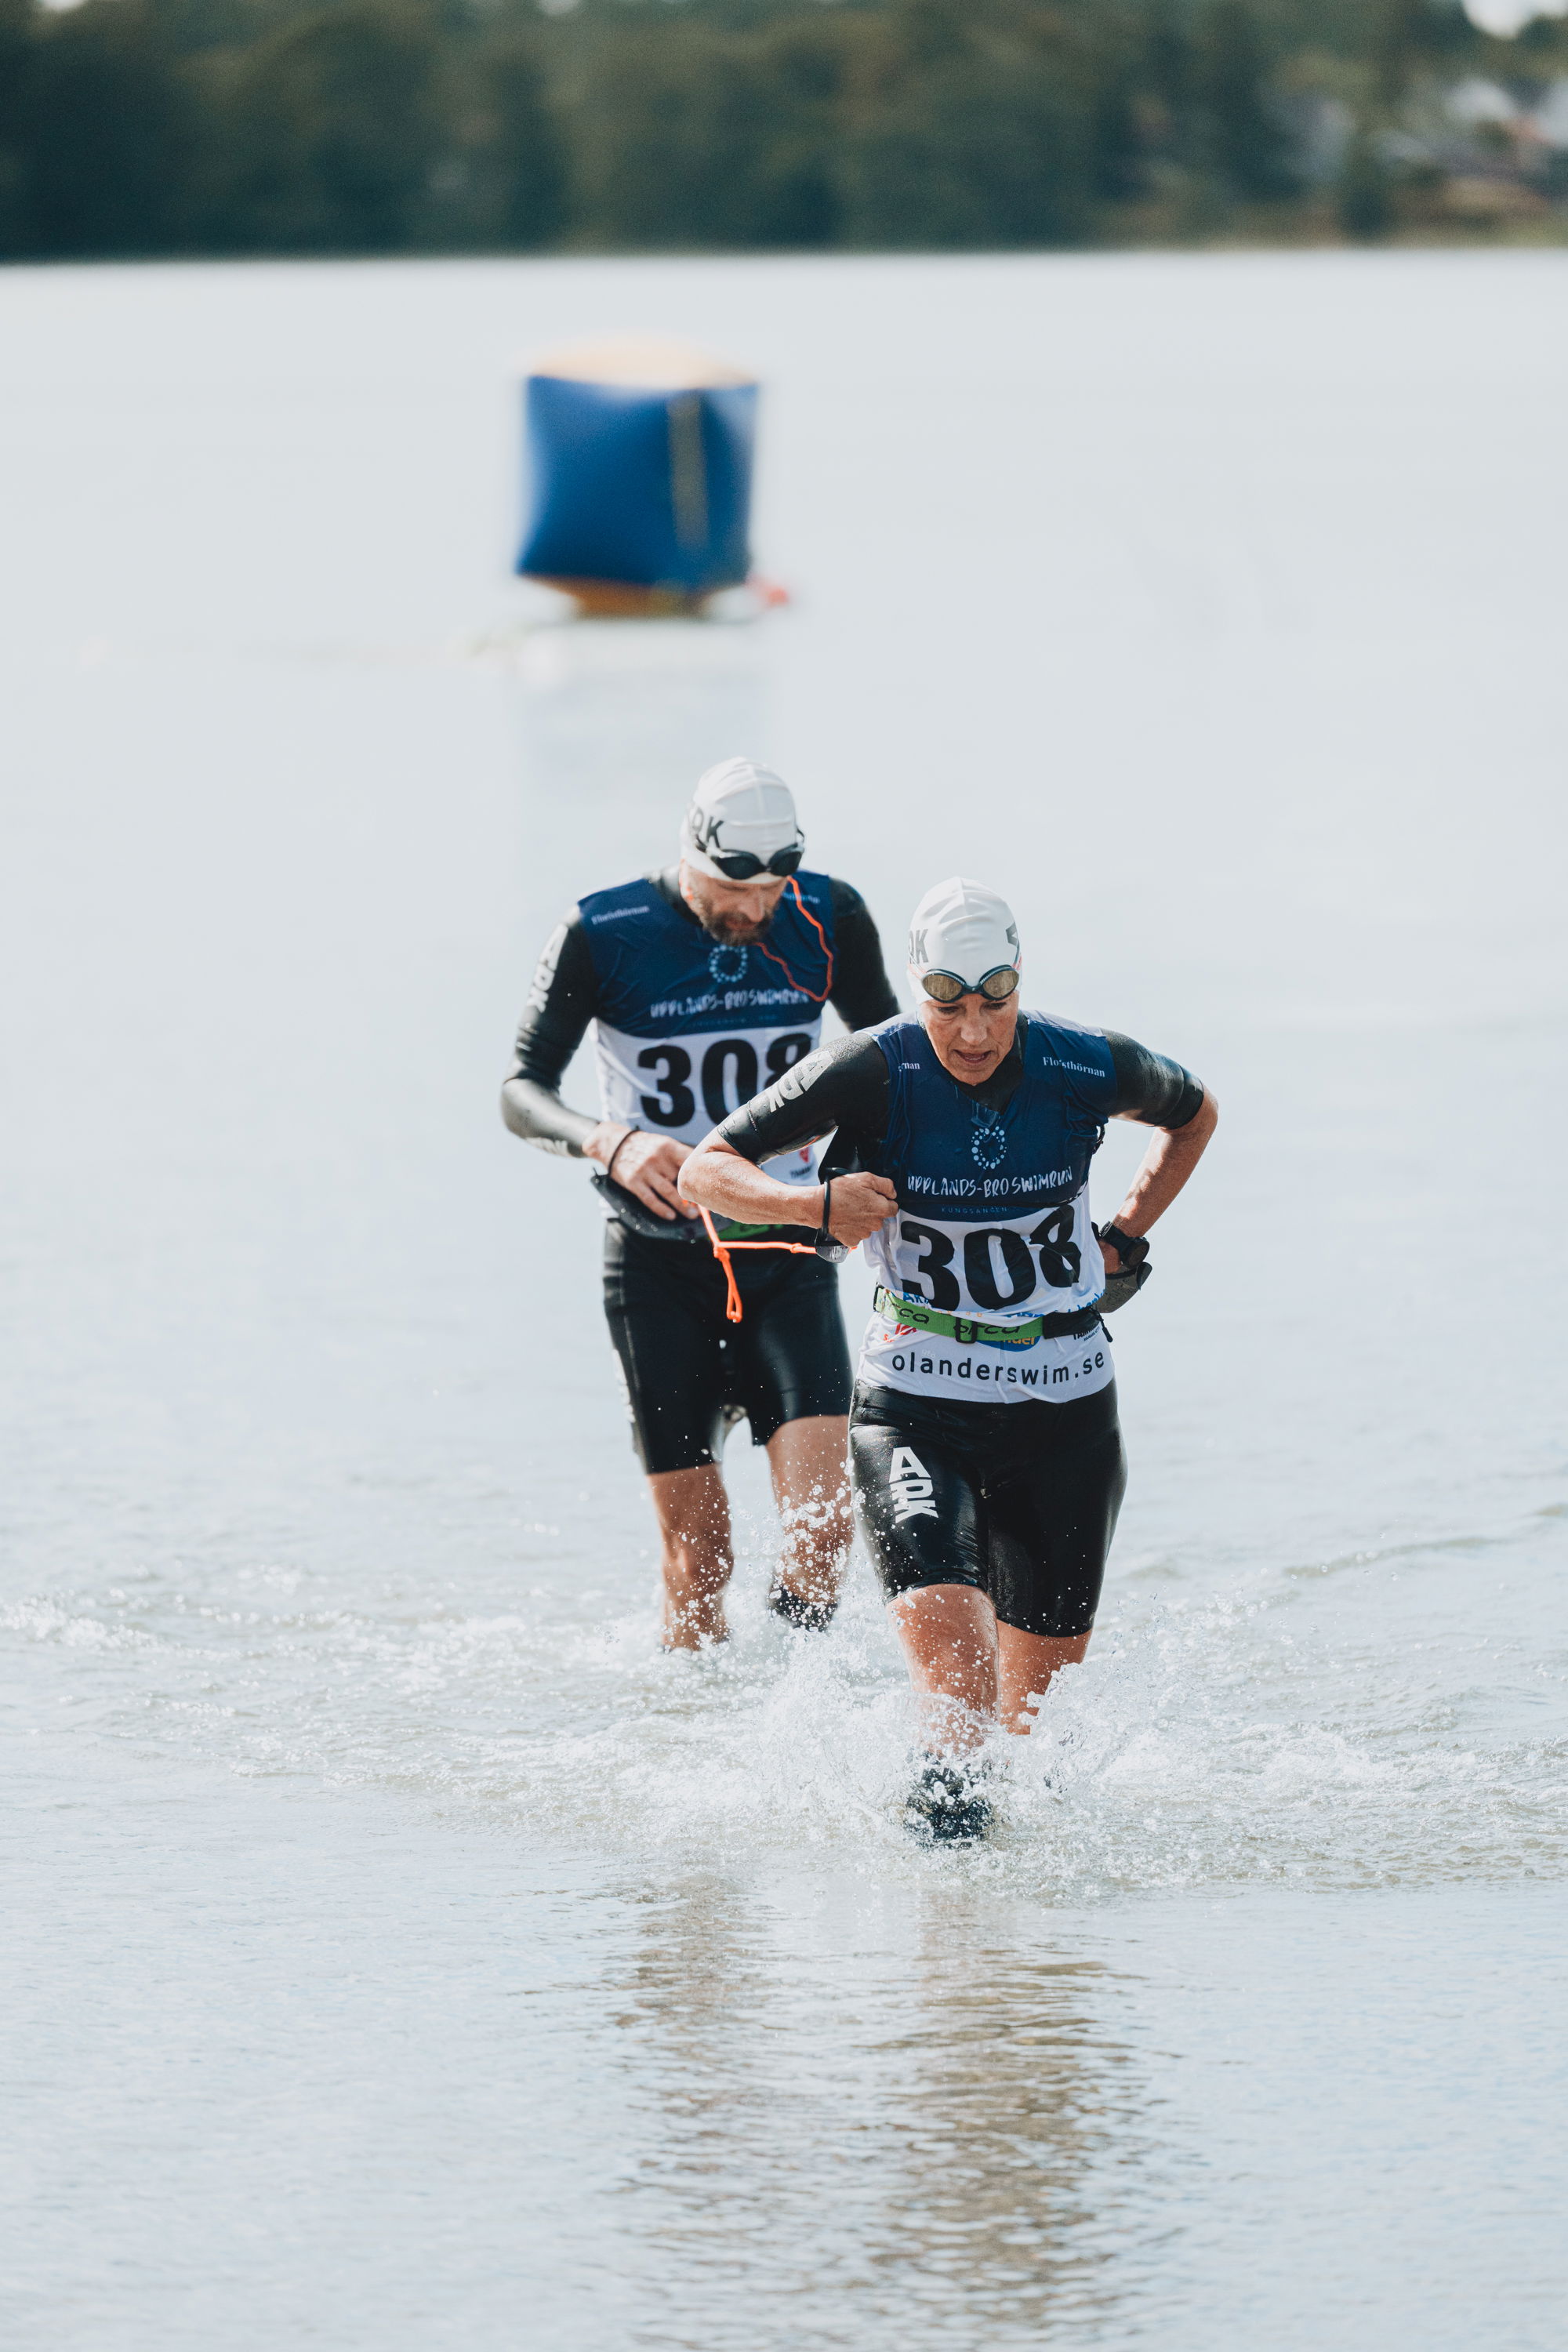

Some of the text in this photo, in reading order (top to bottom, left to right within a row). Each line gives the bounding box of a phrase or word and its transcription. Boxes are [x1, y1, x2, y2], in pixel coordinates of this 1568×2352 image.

[908, 1166, 1073, 1198] UPPLANDS-BRO SWIMRUN
[901, 1205, 1082, 1312] 308
[892, 1351, 1105, 1385] olanderswim.se
